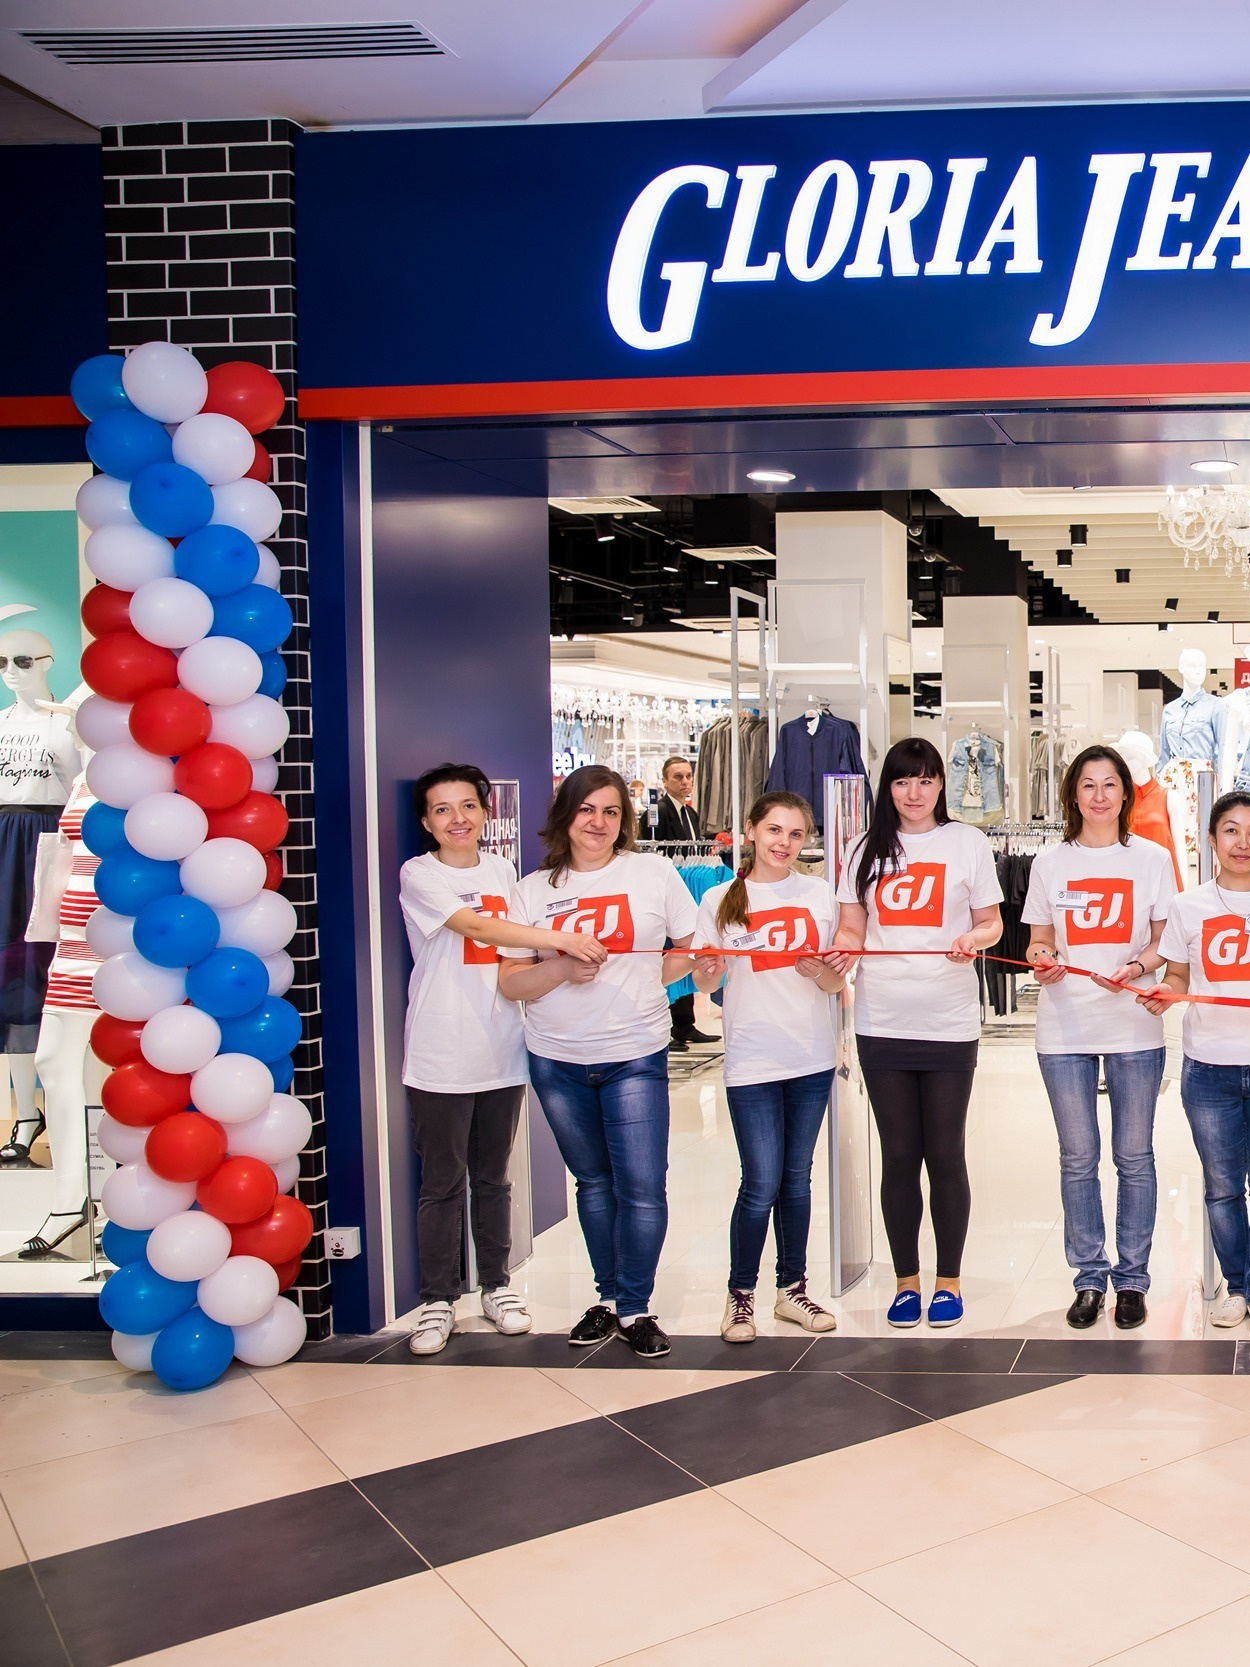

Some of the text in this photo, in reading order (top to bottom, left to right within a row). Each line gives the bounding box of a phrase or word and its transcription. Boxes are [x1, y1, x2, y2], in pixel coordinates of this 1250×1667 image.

[606, 156, 1043, 351] GLORIA
[1, 734, 40, 747] GOOD
[39, 748, 56, 764] IS
[481, 818, 516, 845] ОДНАЯ
[880, 875, 936, 911] GJ
[1072, 892, 1124, 929] GJ
[760, 918, 807, 952] GJ
